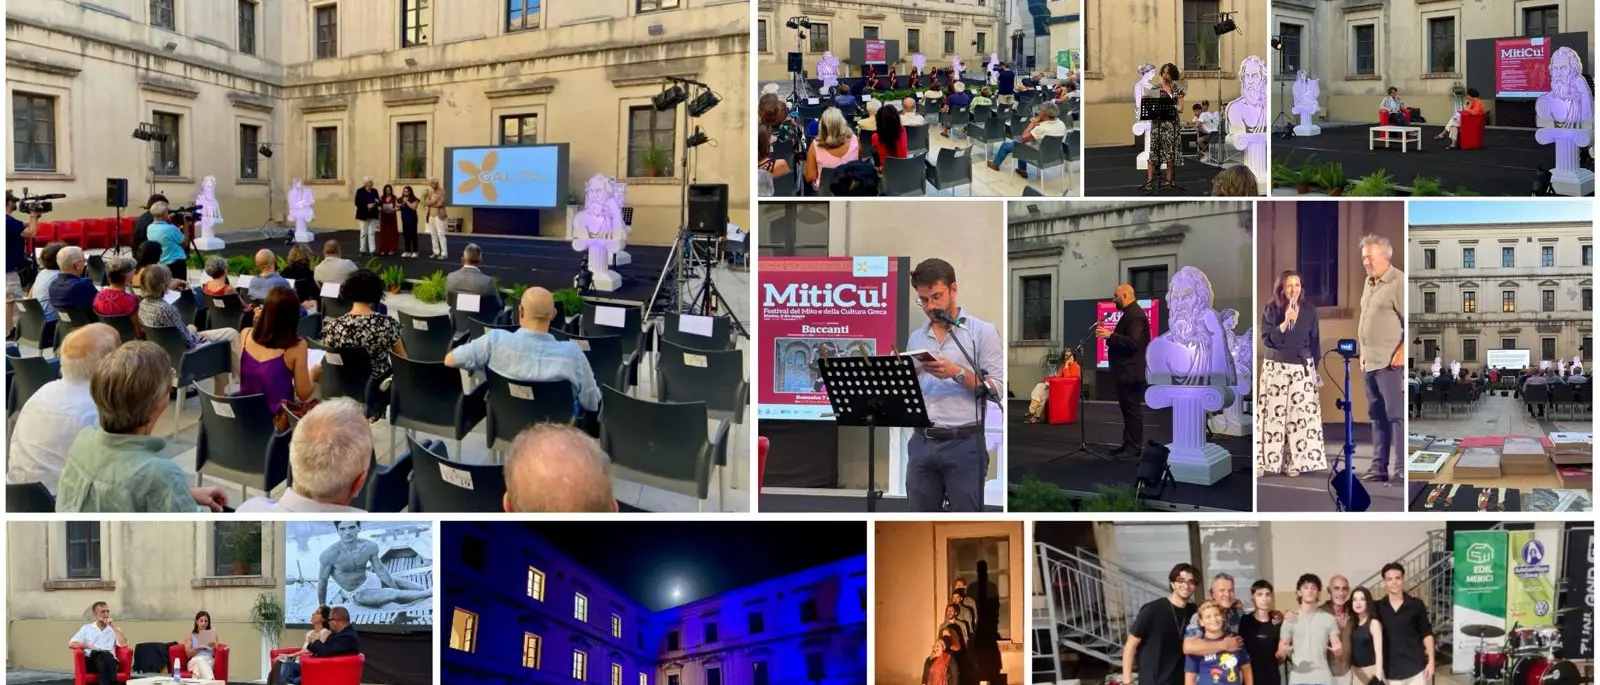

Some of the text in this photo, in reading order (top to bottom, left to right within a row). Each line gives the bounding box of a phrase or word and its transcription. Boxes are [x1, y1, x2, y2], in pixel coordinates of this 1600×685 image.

[1501, 47, 1544, 57] MitiCu!
[763, 282, 887, 307] MitiCu!
[802, 325, 849, 334] Baccanti
[1473, 565, 1493, 573] EDIL
[1466, 575, 1494, 583] MERICI
